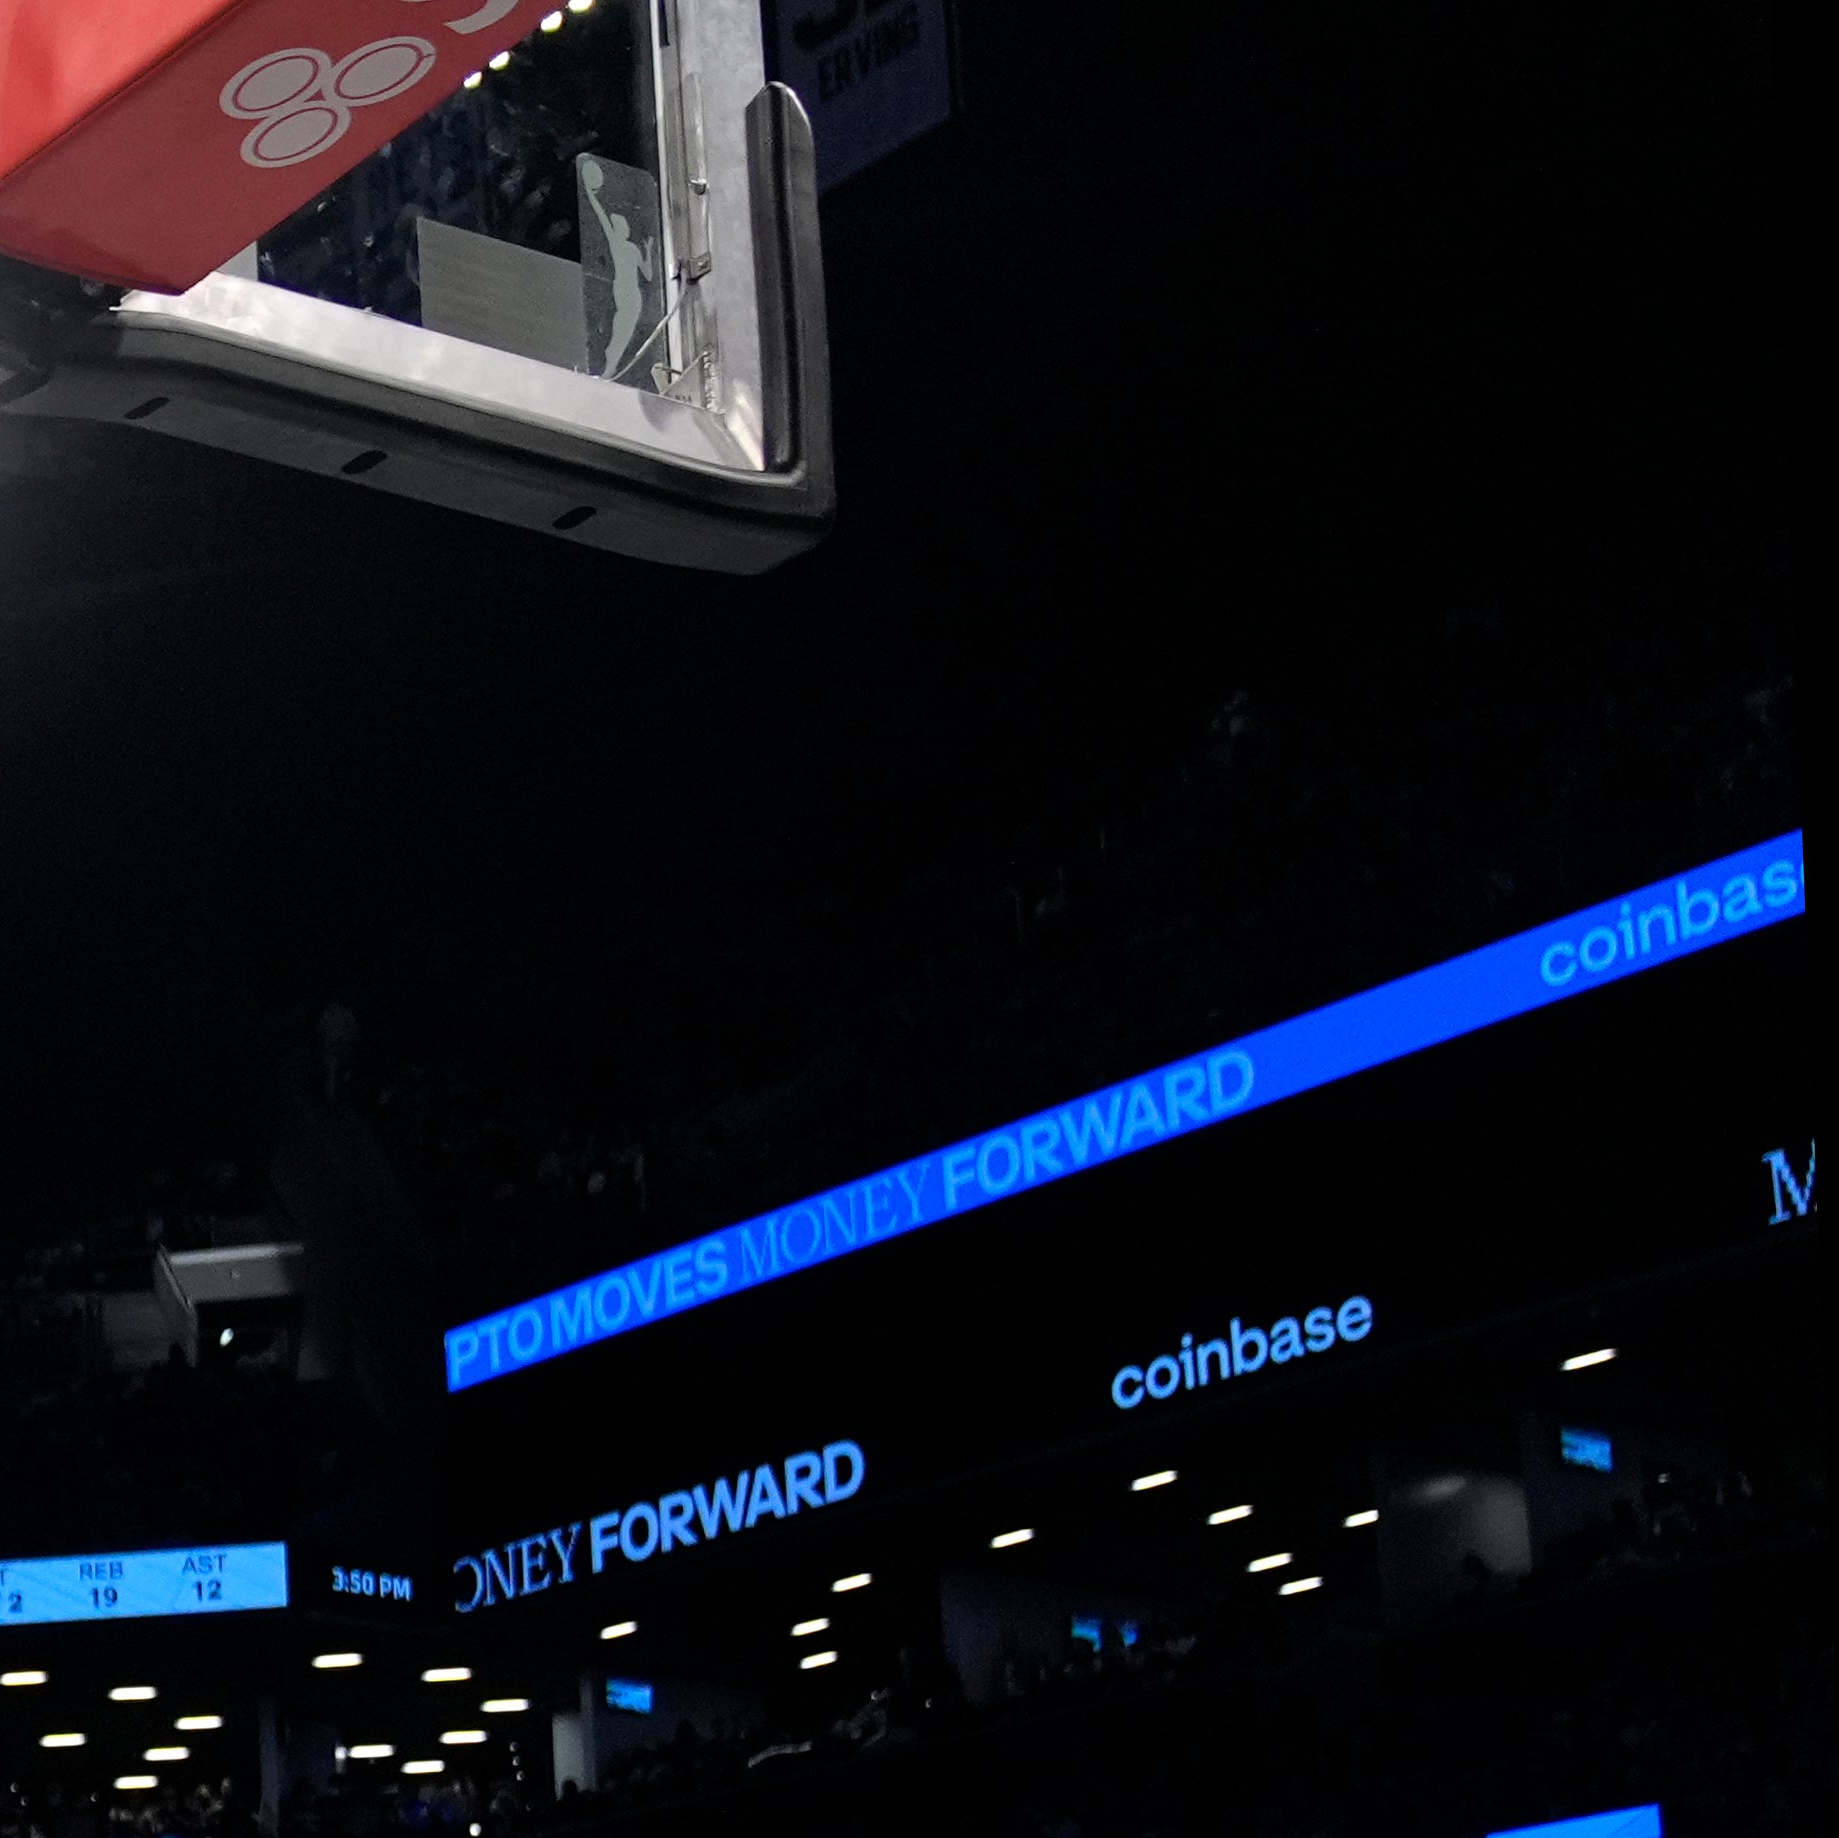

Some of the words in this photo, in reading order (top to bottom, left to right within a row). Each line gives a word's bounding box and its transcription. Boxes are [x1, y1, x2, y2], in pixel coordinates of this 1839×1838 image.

[1540, 860, 1805, 987] coinbas
[549, 1239, 728, 1352] MOVES
[737, 1160, 931, 1284] MONEY
[941, 1048, 1255, 1212] FORWARD
[1111, 1295, 1374, 1409] coinbase
[590, 1439, 866, 1574] FORWARD
[79, 1561, 124, 1581] REB
[181, 1552, 227, 1575] AST
[90, 1587, 119, 1609] 19
[194, 1579, 222, 1602] 12
[332, 1566, 374, 1596] 3:50
[379, 1572, 413, 1601] PM
